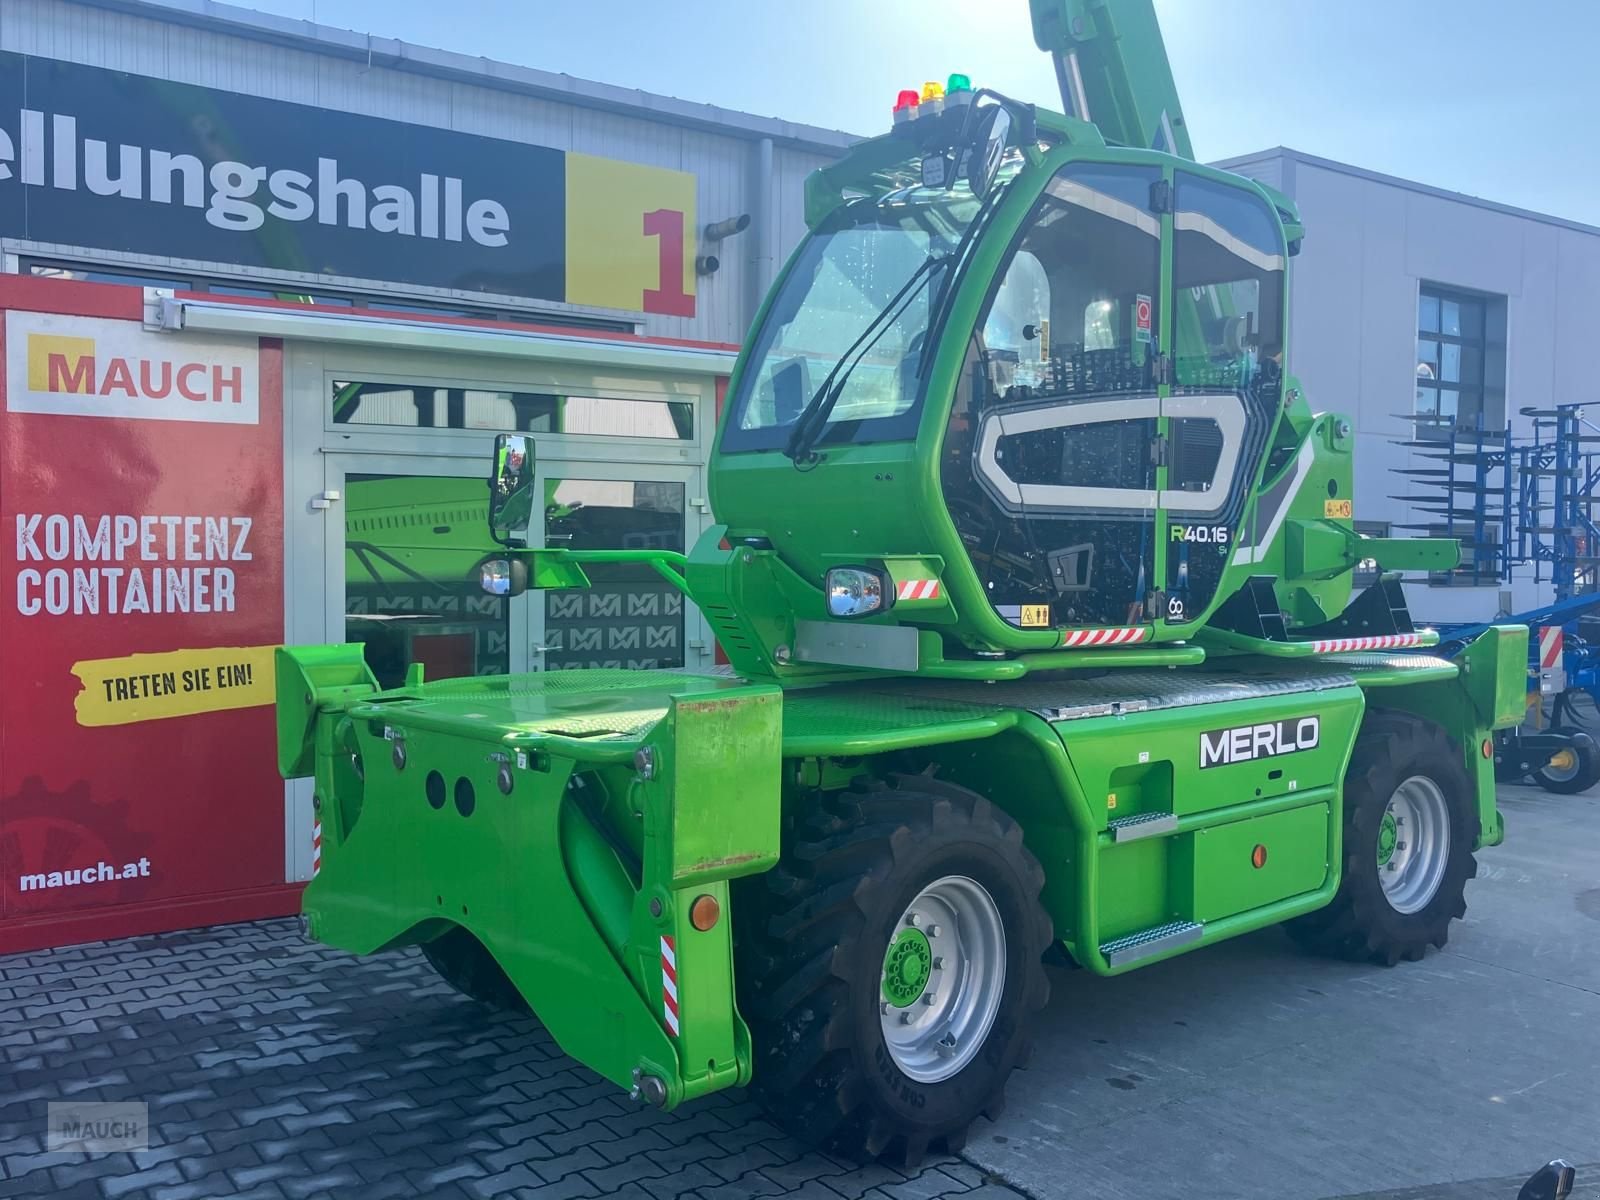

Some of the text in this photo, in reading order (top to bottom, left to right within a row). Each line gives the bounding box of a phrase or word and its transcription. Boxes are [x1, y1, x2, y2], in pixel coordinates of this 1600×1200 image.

[643, 209, 696, 318] 1
[48, 353, 242, 403] MAUCH
[16, 514, 252, 561] KOMPETENZ
[1171, 525, 1227, 543] R40.16
[17, 567, 235, 615] CONTAINER
[103, 663, 253, 702] TRETEN SIE EIN!
[1200, 717, 1319, 768] MERLO
[20, 857, 150, 891] mauch.at
